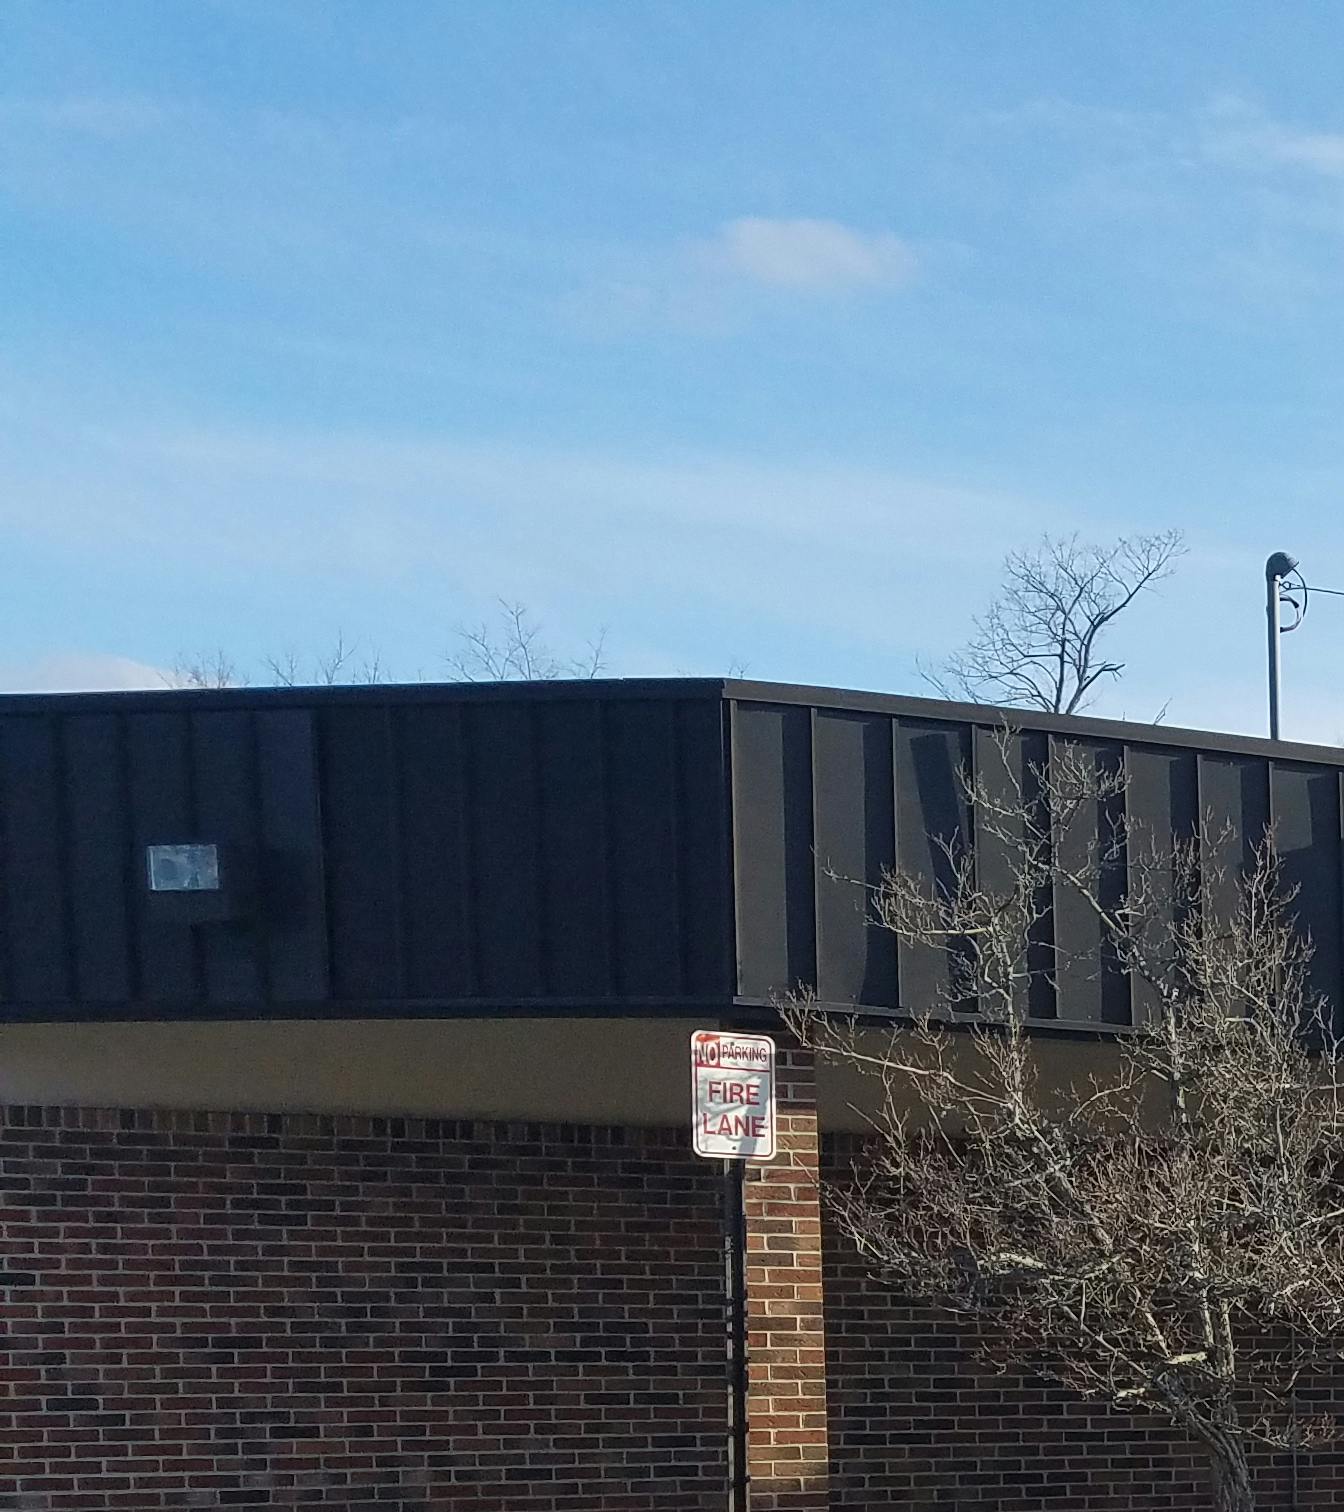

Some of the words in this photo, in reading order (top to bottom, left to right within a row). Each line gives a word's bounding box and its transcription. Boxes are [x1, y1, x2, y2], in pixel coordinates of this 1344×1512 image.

[697, 1042, 718, 1065] NO
[722, 1044, 767, 1062] PARKING
[708, 1081, 760, 1105] FIRE
[703, 1113, 766, 1137] LANE
